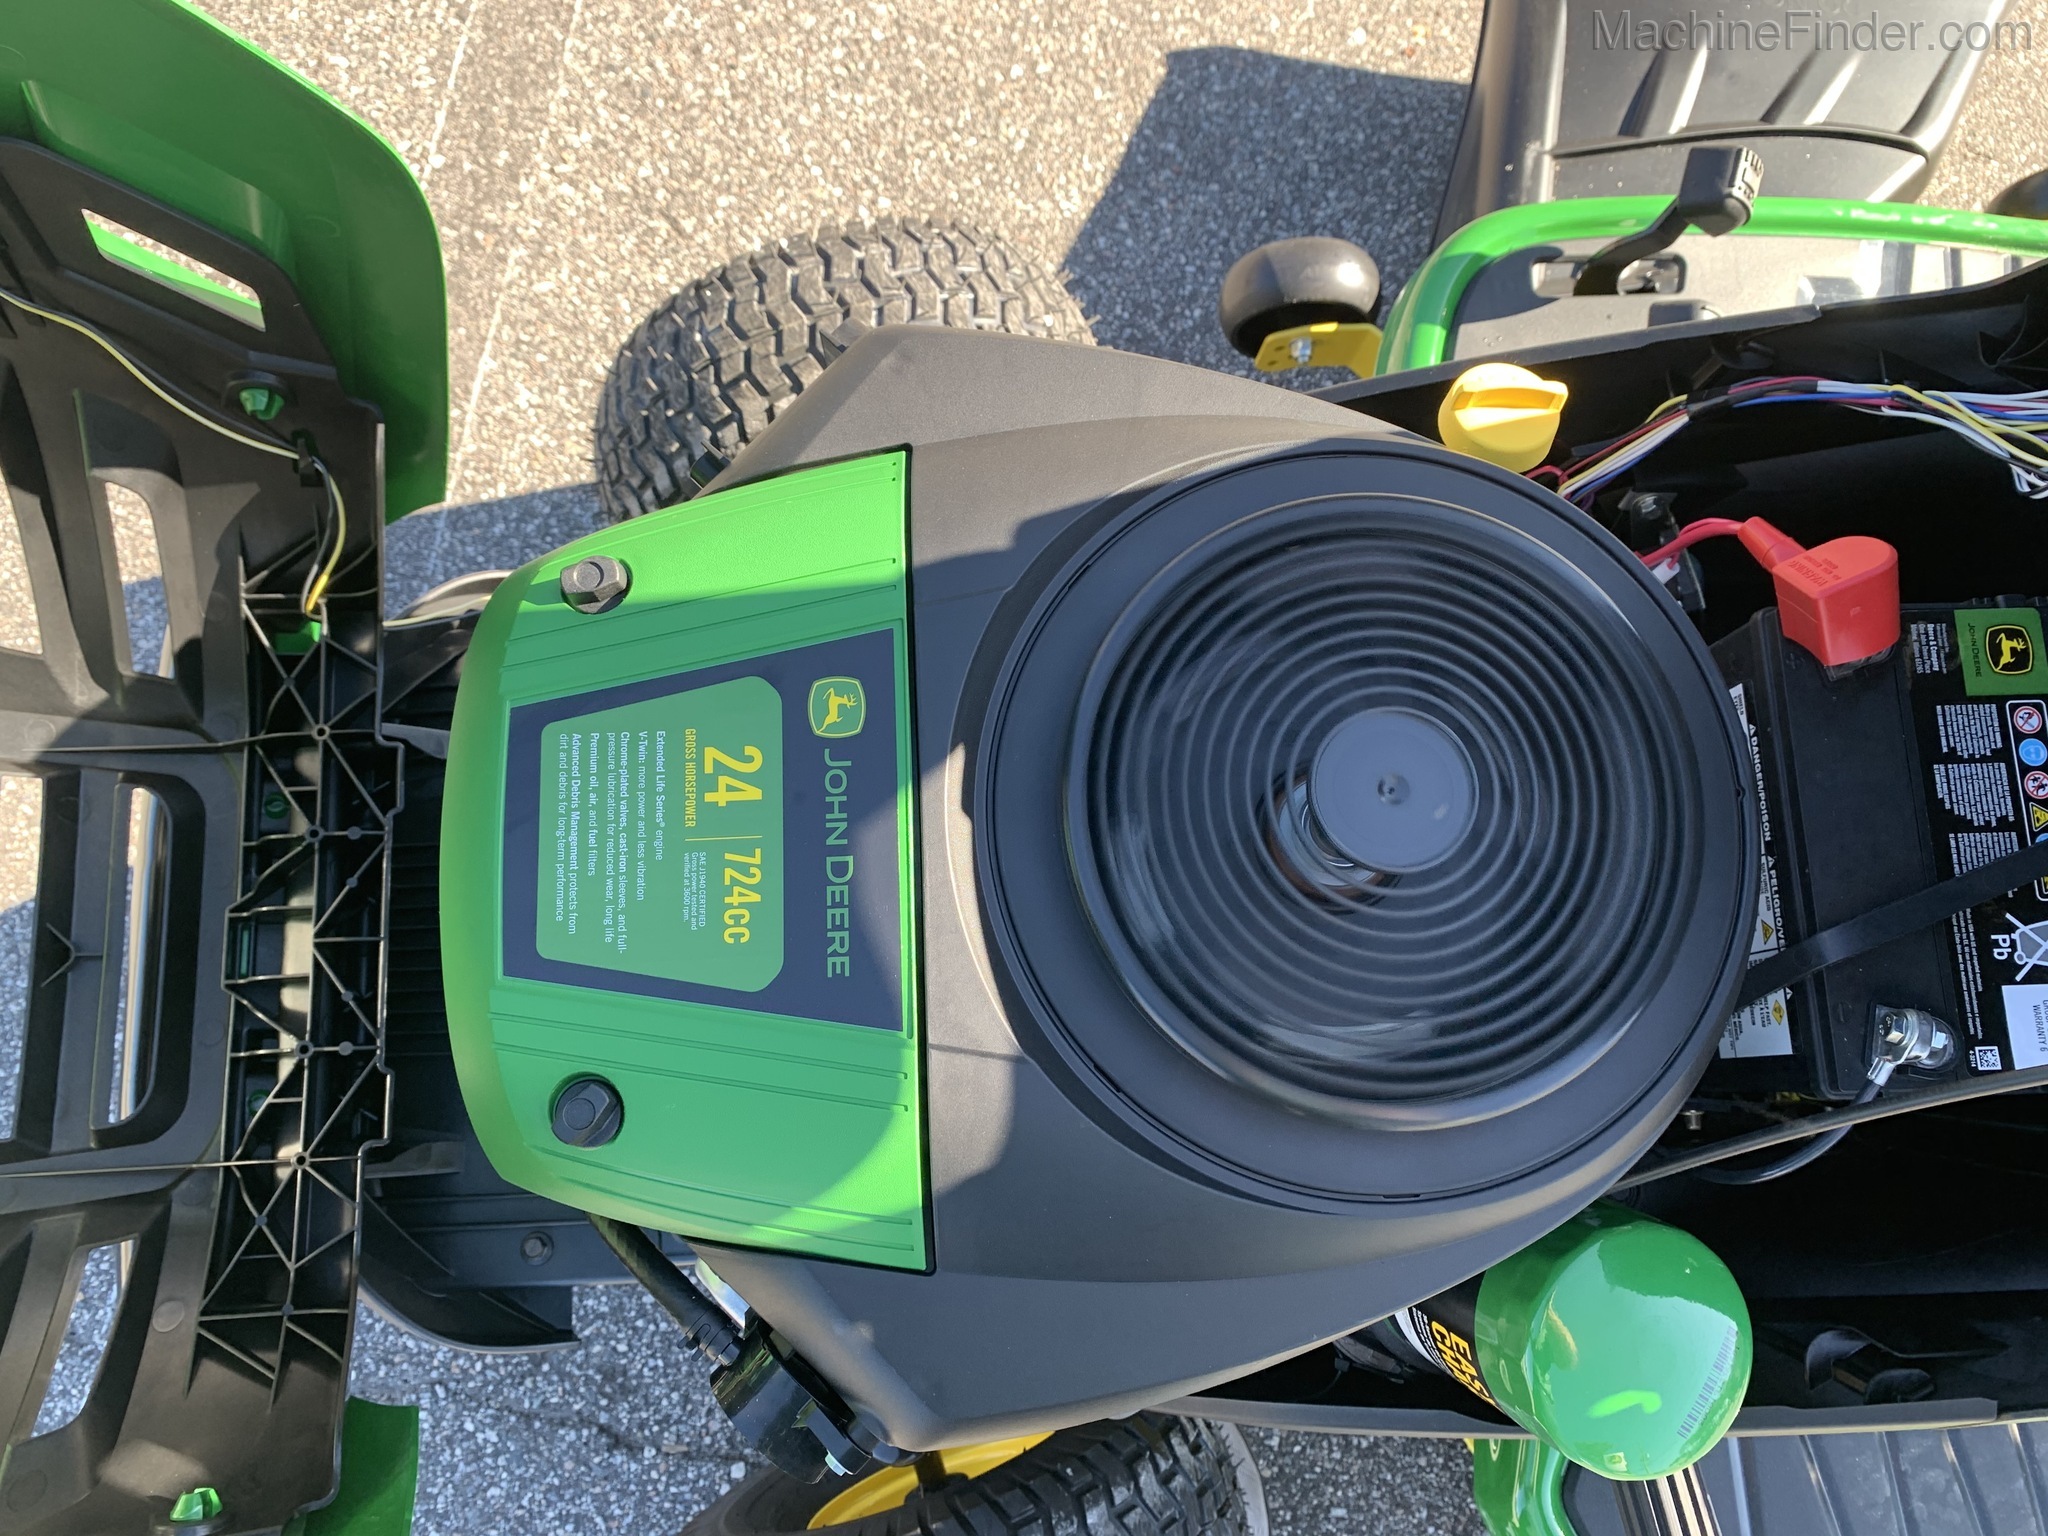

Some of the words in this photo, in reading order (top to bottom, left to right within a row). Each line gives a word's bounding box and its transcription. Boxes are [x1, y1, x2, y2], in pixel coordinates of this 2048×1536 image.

[1968, 623, 1977, 647] JOHN
[1930, 646, 1940, 671] Company
[1972, 648, 1982, 677] DEERE
[559, 734, 569, 749] dirt
[572, 733, 582, 777] Advanced
[589, 733, 600, 773] Premium
[606, 732, 616, 770] pressure
[638, 731, 648, 764] V-Twin:
[656, 730, 666, 772] Extended
[685, 728, 697, 759] GROSS
[559, 752, 568, 768] and
[619, 731, 630, 797] Chrome-plated
[558, 771, 568, 800] debris
[588, 776, 599, 790] oil,
[638, 766, 646, 788] more
[656, 775, 666, 792] Life
[704, 745, 763, 807] 24
[1751, 736, 1772, 841] DANGER/POISON
[571, 779, 581, 808] Debris
[588, 792, 598, 807] air,
[606, 772, 617, 820] lubrication
[636, 791, 646, 818] power
[685, 762, 697, 827] HORSEPOWER
[824, 749, 852, 846] JOHN
[558, 802, 568, 817] for
[588, 810, 598, 827] and
[618, 799, 629, 830] valves,
[556, 817, 567, 861] long-term
[569, 811, 580, 870] Management
[588, 829, 598, 847] fuel
[606, 823, 616, 835] for
[638, 820, 646, 838] and
[606, 838, 616, 875] reduced
[619, 832, 628, 873] cast-iron
[637, 840, 646, 858] less
[653, 830, 665, 861] engine
[587, 850, 598, 876] filters
[683, 852, 691, 877] verified
[691, 852, 699, 871] Gross
[555, 863, 566, 922] performance
[568, 873, 579, 910] protects
[604, 878, 614, 902] wear,
[617, 874, 628, 911] sleeves,
[637, 860, 646, 901] vibration
[683, 878, 690, 886] at
[698, 890, 706, 927] CERTIFIED
[724, 848, 762, 944] 724cc
[1769, 869, 1786, 951] PELIGRO/VE
[568, 913, 579, 934] from
[603, 905, 615, 925] long
[618, 914, 627, 932] and
[690, 917, 698, 930] and
[826, 855, 854, 978] DEERE
[605, 928, 614, 943] life
[617, 934, 627, 954] full-
[1990, 934, 2011, 960] Pb
[2033, 1005, 2047, 1045] WARRANTY
